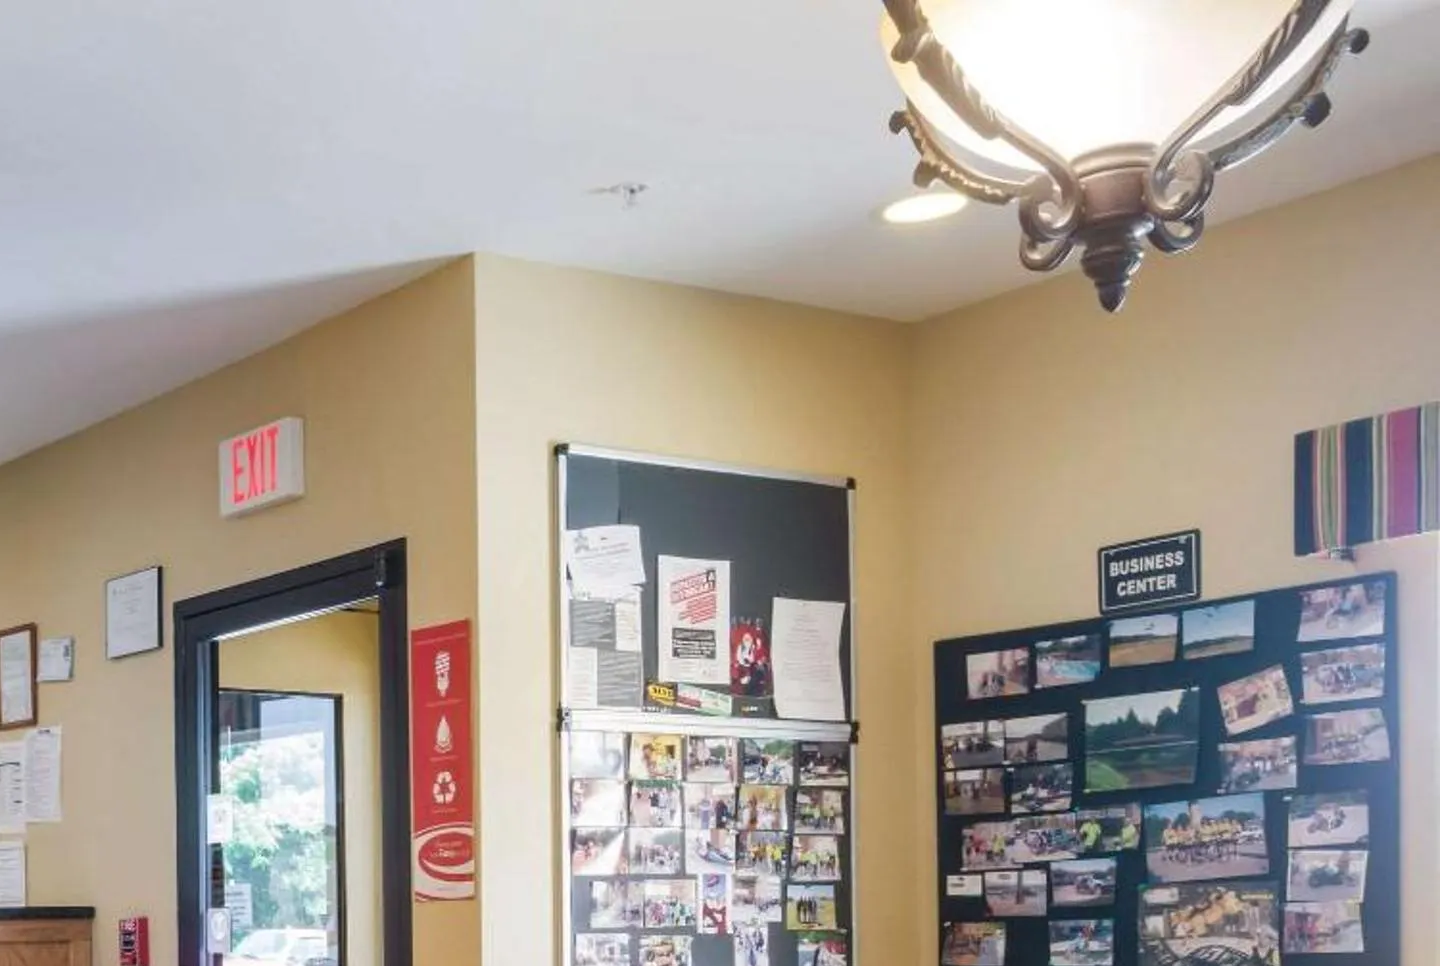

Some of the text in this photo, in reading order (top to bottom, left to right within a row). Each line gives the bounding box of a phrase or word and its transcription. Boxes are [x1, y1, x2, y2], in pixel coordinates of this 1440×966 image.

[231, 426, 279, 504] EXIT
[1109, 551, 1184, 577] BUSINESS
[1116, 575, 1177, 597] CENTER
